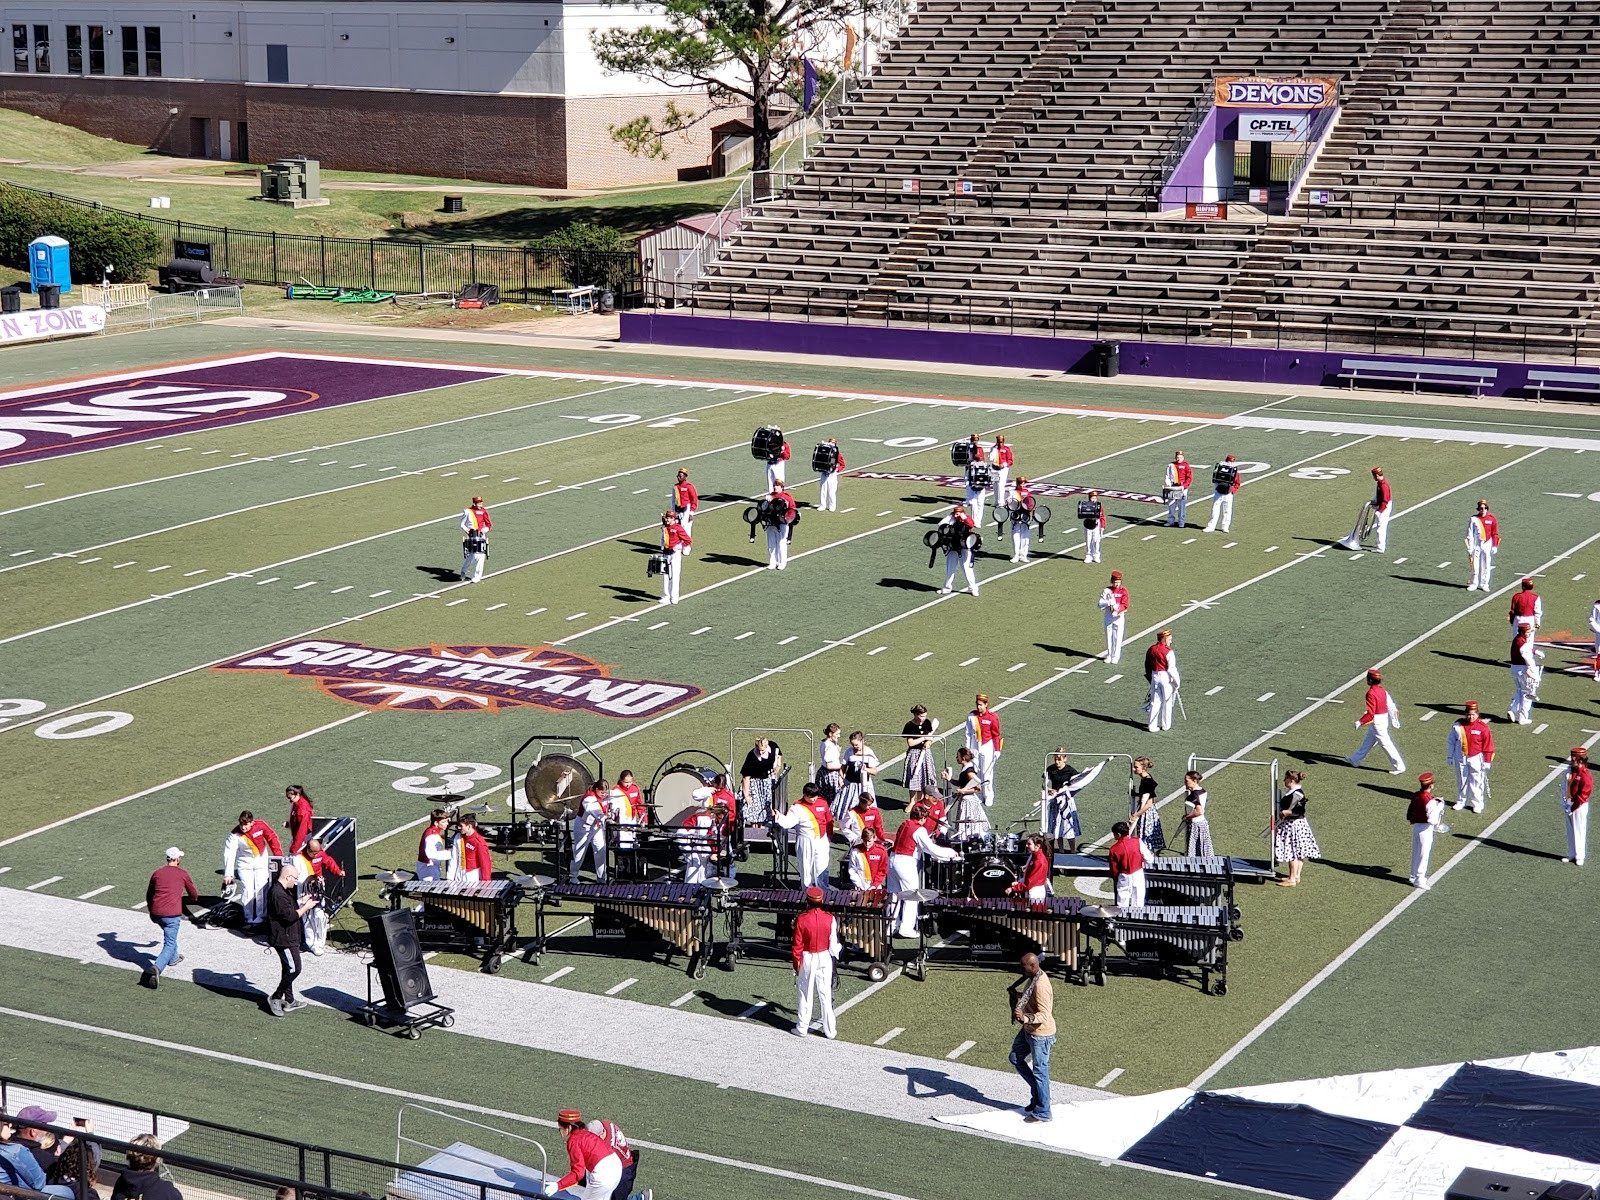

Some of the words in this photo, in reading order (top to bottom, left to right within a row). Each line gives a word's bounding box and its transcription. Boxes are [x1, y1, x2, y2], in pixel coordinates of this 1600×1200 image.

[1230, 84, 1323, 104] DEMONS
[1250, 119, 1294, 130] CP-TEL
[239, 640, 689, 715] SOUTHLAND
[310, 667, 570, 706] CONFERENCE
[595, 927, 626, 935] pro-mark
